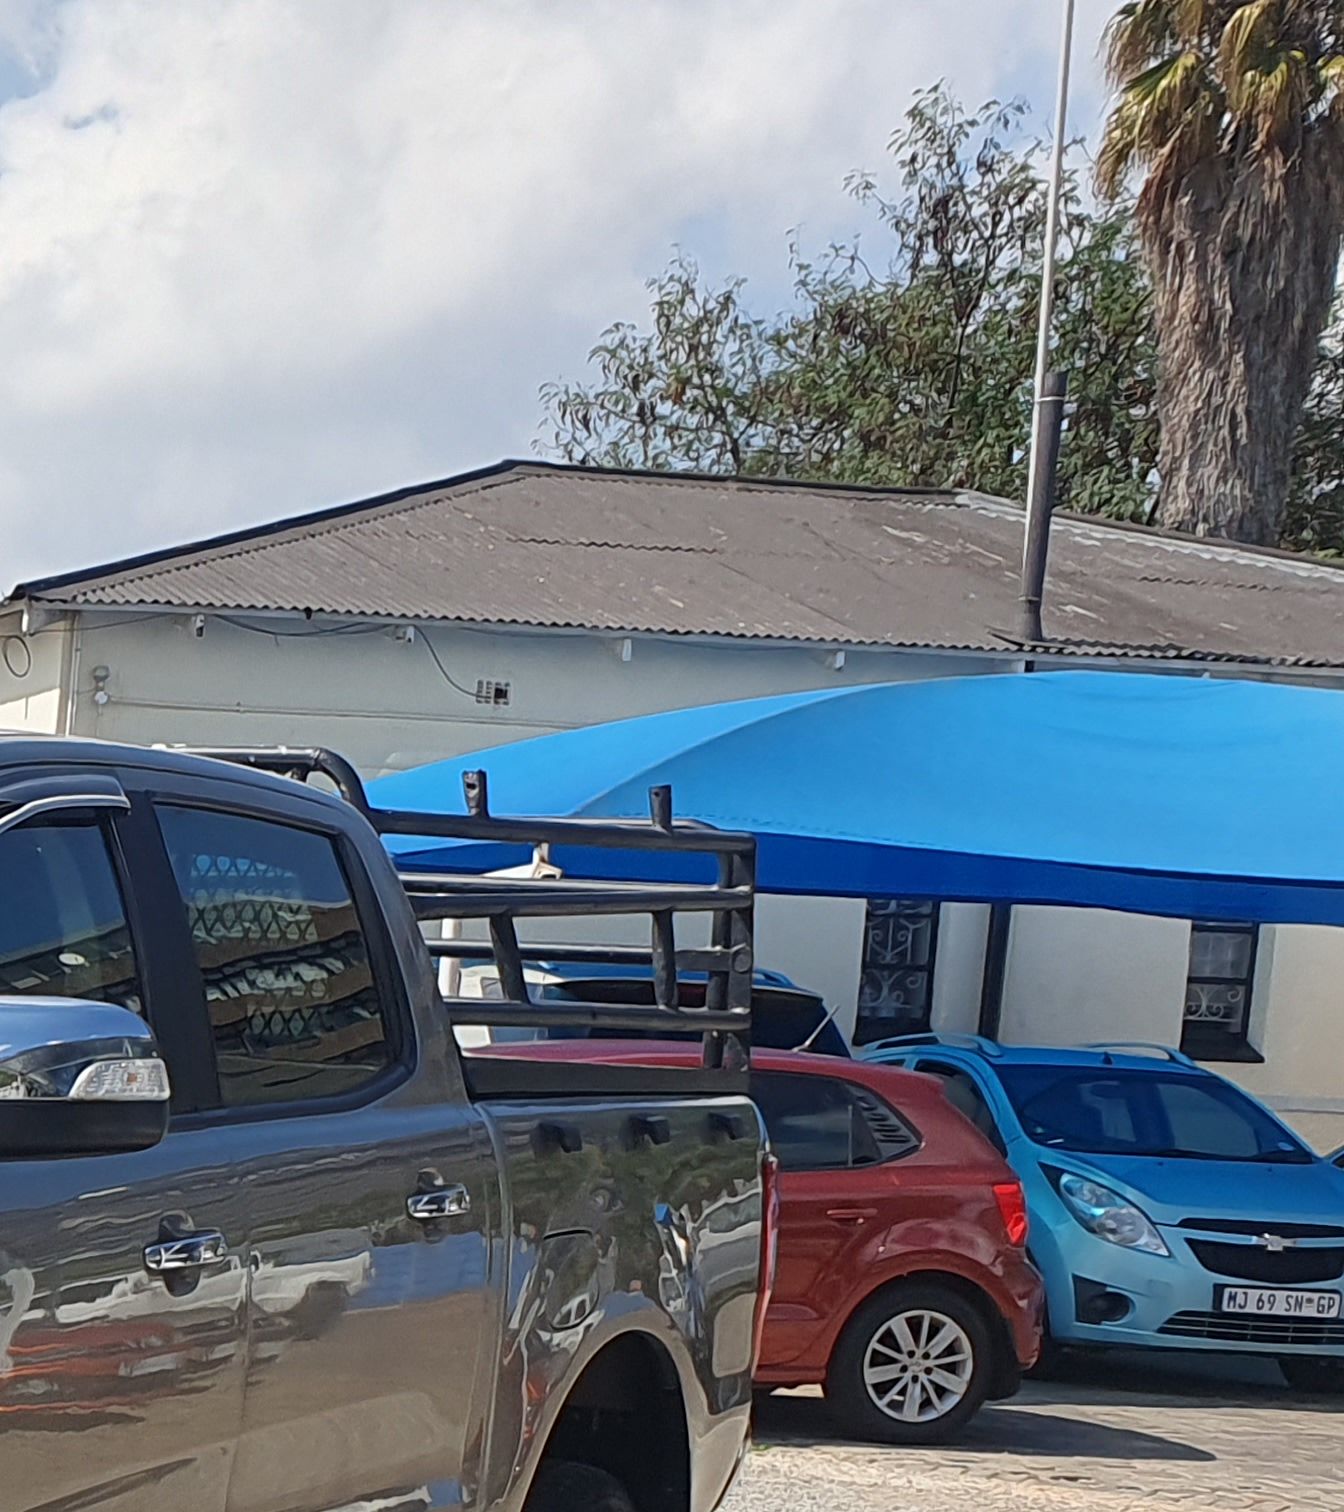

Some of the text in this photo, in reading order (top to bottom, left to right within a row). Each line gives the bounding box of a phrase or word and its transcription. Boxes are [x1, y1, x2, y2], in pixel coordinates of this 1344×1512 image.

[1256, 1293, 1277, 1312] 69
[1284, 1294, 1304, 1313] SN
[1316, 1296, 1336, 1315] GP
